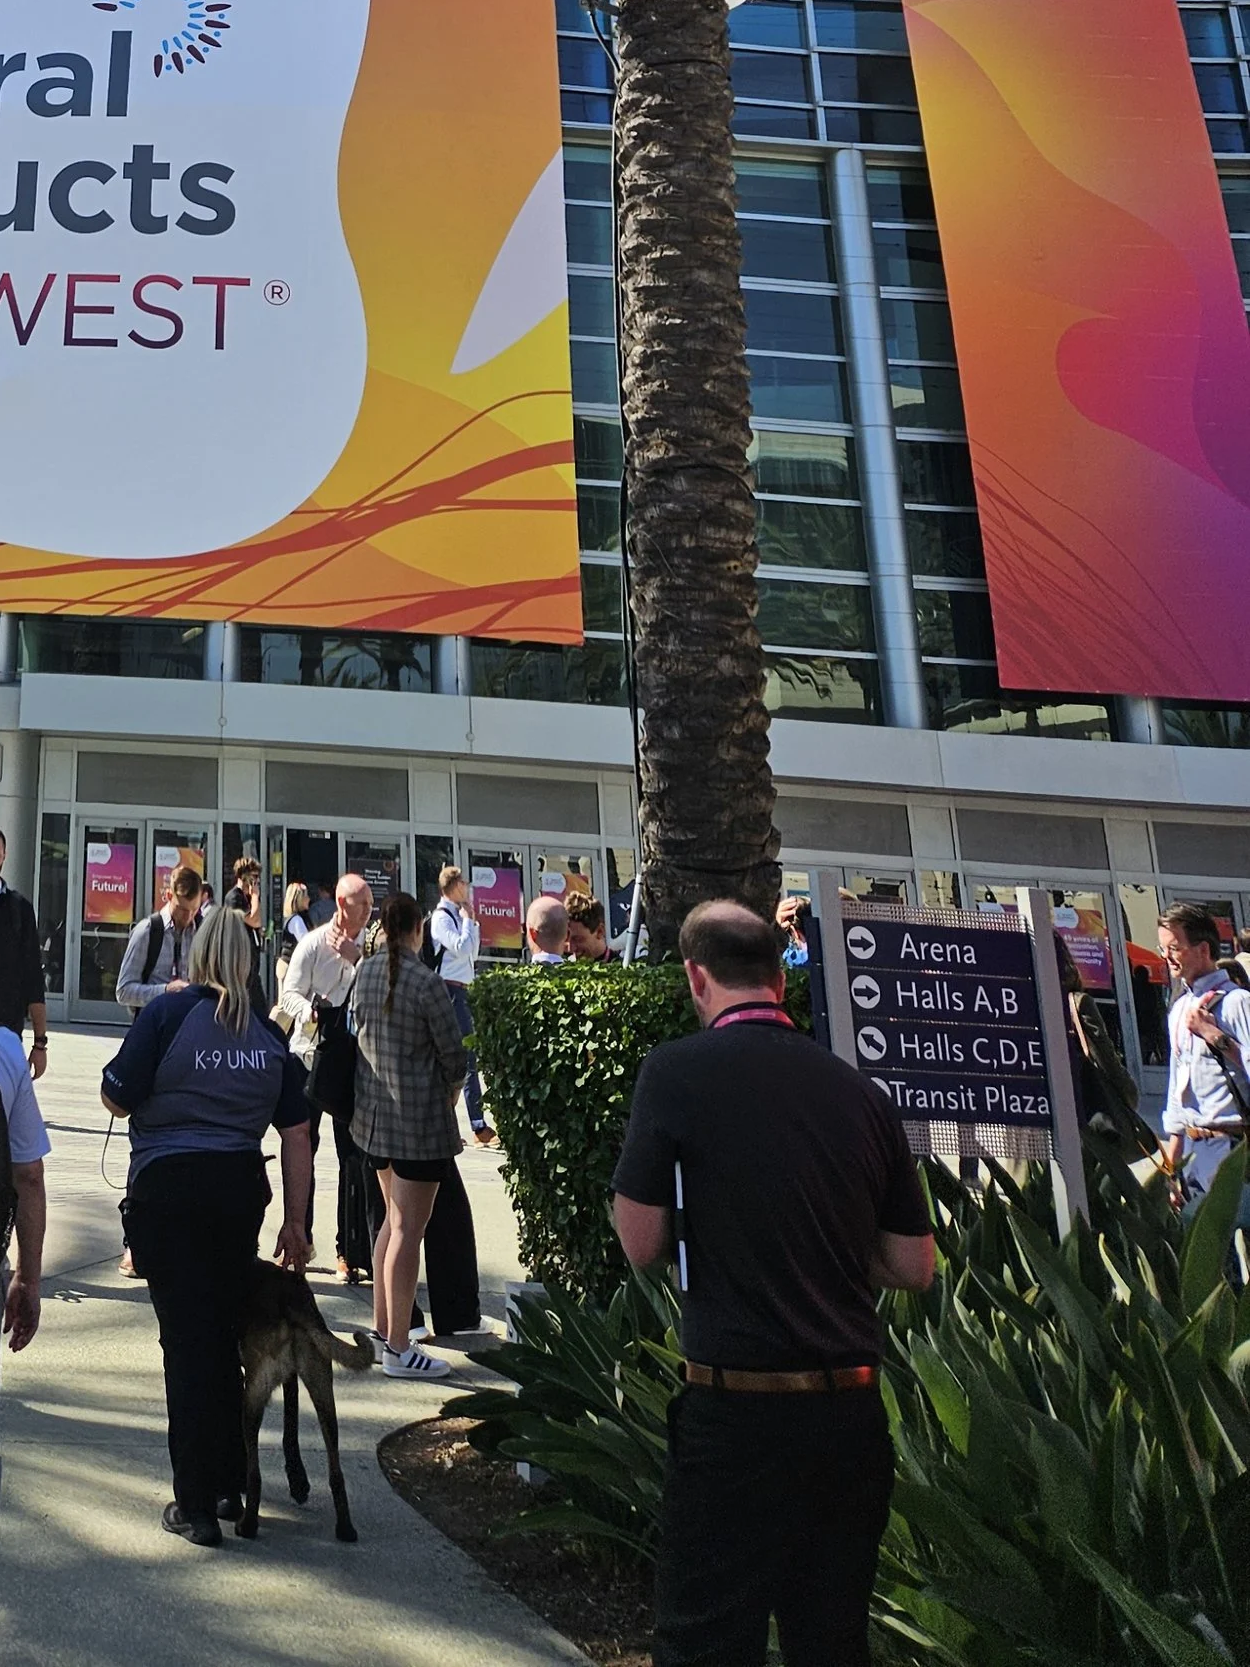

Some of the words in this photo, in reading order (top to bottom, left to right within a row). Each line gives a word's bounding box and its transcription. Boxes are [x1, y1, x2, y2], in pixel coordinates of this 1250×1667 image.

[92, 879, 128, 894] Future!
[478, 904, 515, 918] Future!
[900, 932, 977, 965] Arena
[896, 980, 964, 1011] Halls
[974, 985, 1019, 1019] A,B
[195, 1049, 222, 1070] K-9
[227, 1049, 267, 1070] UNIT
[900, 1033, 964, 1062] Halls
[972, 1038, 1044, 1071] C,D,E
[889, 1080, 977, 1111] Transit
[985, 1085, 1051, 1115] Plaza
